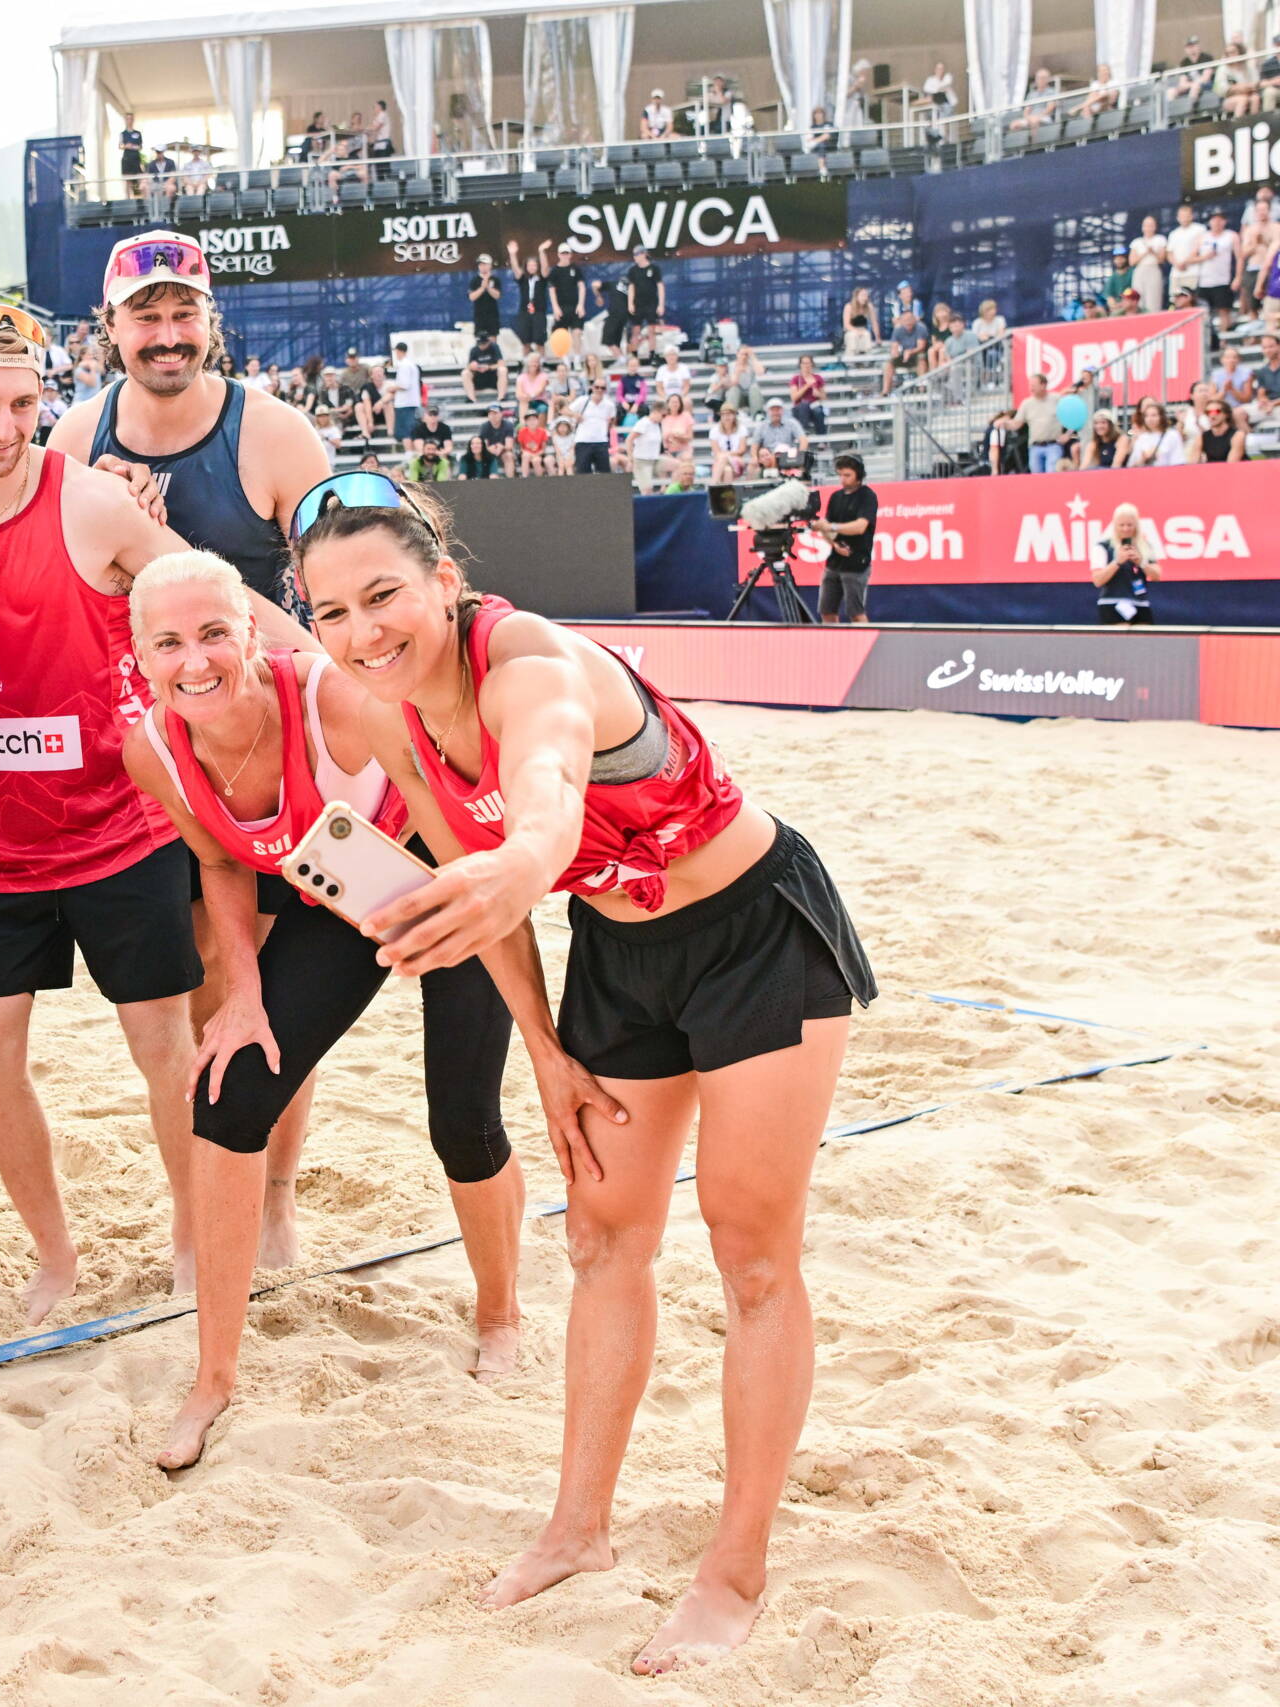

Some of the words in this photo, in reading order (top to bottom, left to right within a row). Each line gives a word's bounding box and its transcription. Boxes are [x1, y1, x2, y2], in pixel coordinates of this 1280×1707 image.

[896, 503, 956, 518] Equipment
[797, 520, 964, 563] Snoh
[464, 789, 505, 823] SUI
[252, 833, 293, 856] SUI
